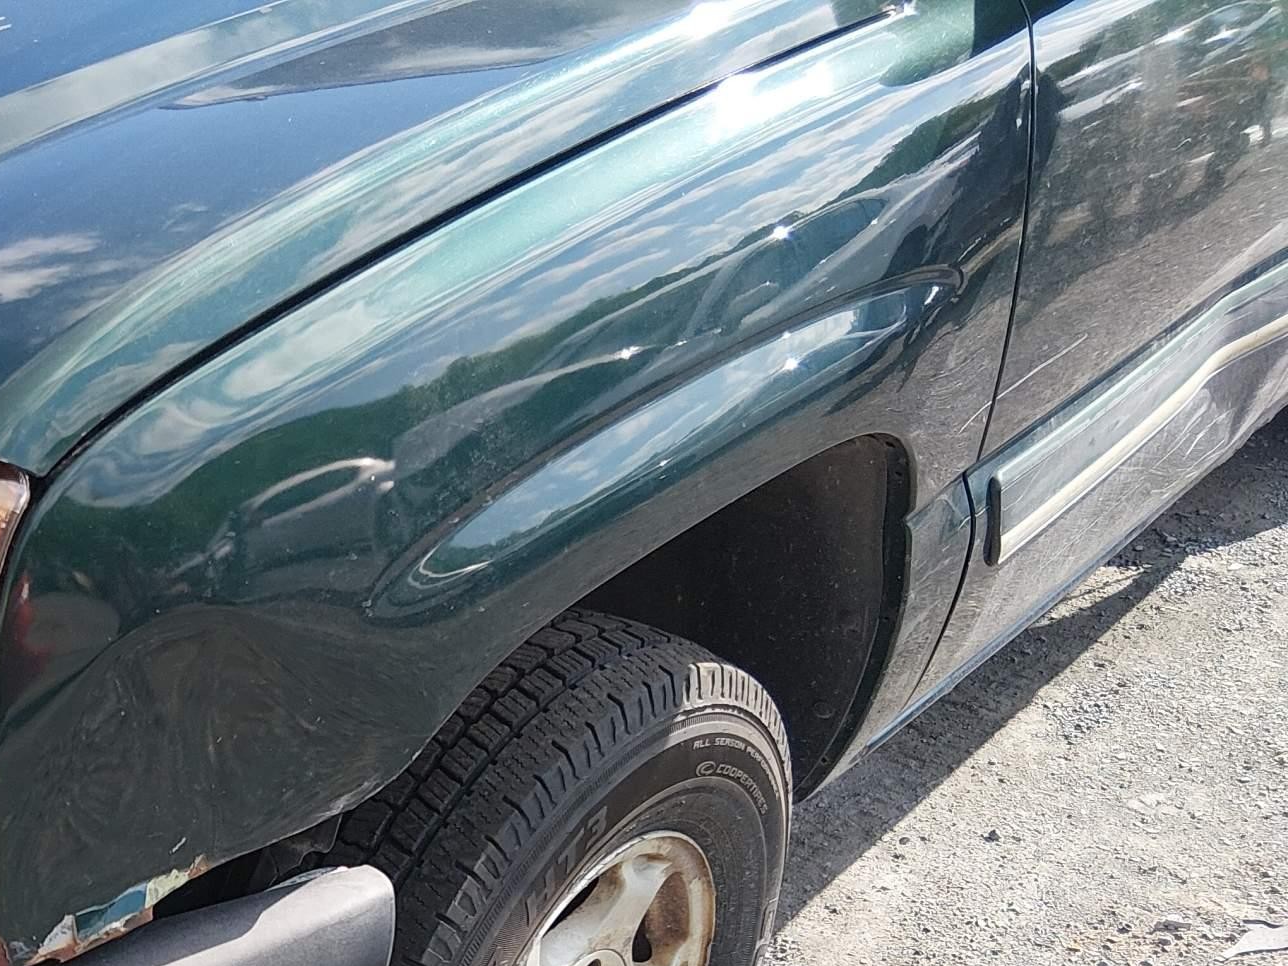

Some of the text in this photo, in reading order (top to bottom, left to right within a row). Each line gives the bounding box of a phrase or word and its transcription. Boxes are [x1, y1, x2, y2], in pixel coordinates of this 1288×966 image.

[693, 739, 711, 750] ALL
[714, 738, 745, 750] SEASON
[524, 806, 608, 928] HT3
